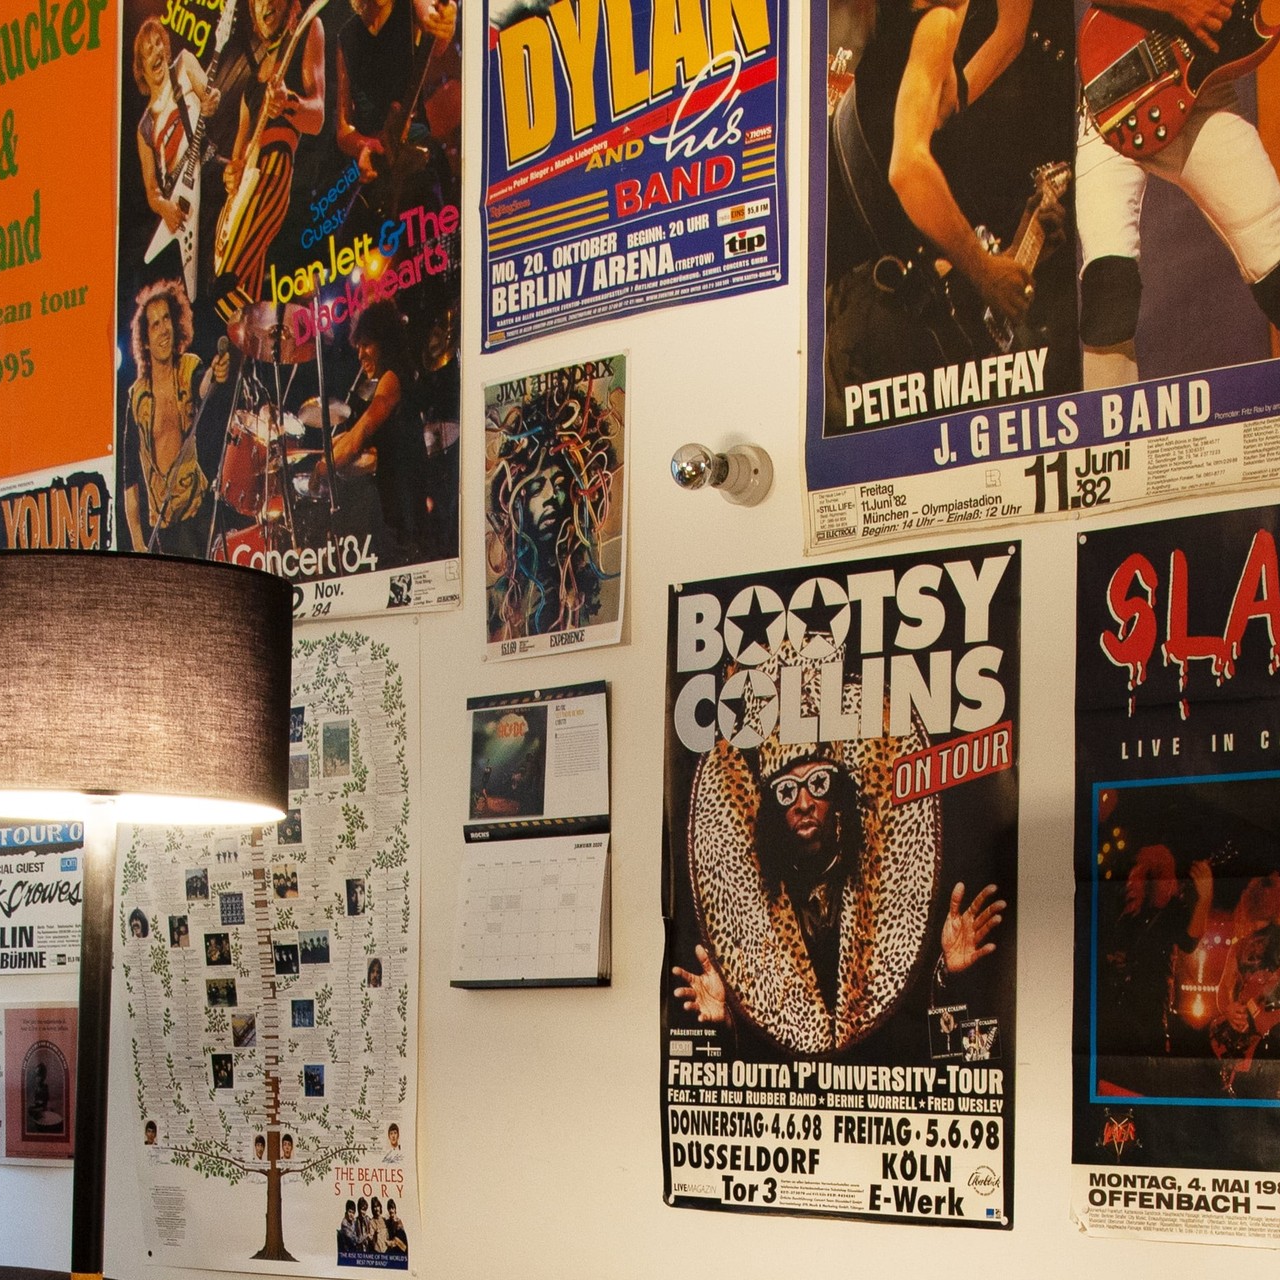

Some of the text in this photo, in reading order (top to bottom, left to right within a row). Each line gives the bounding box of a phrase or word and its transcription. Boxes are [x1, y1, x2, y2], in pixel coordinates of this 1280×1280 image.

[160, 0, 212, 58] Sting
[585, 139, 644, 173] AND
[310, 159, 361, 222] Special
[615, 154, 735, 218] BAND
[270, 204, 460, 309] Joan Jett & The
[492, 213, 710, 282] MO, 20. OKTOBER BEGINN: 20 UHR
[726, 231, 765, 253] tip
[40, 284, 88, 316] tour
[292, 243, 449, 347] Blackhearts
[492, 269, 572, 317] BERLIN
[593, 243, 675, 292] ARENA
[675, 252, 714, 271] (TREPTOW)
[496, 358, 614, 403] JIMI HENDRIX
[844, 346, 1048, 427] PETER MAFFAY
[933, 379, 1211, 466] J. GEILS BAND
[1075, 441, 1130, 478] Juni
[859, 483, 894, 499] Freitag
[863, 509, 909, 526] München
[921, 494, 1002, 516] Olympiastadion
[1077, 476, 1111, 508] '82
[1, 482, 101, 550] YOUNG
[862, 503, 1022, 538] Beginn: Uhr Einlaß: 12 Uhr
[231, 534, 378, 578] Concert '84
[314, 581, 345, 600] Nov.
[677, 555, 1012, 673] BOOTSY
[674, 646, 1006, 753] COLLINS
[894, 728, 1011, 800] ON TOUR
[1122, 736, 1181, 760] LIVE
[1211, 732, 1234, 753] IN
[16, 862, 45, 873] GUEST
[7, 879, 83, 916] Crowes
[671, 1109, 1000, 1150] DONNERSTAG 4.6.98 FREITAG 5.6.98
[334, 1167, 404, 1183] THE BEATLES
[672, 1140, 952, 1183] DÜSSELDORF KÖLN
[334, 1182, 404, 1199] STORY
[674, 1182, 717, 1194] LIVEMAGAZIN
[721, 1175, 759, 1202] Tor
[762, 1177, 777, 1204] 3
[869, 1183, 965, 1216] E-Werk
[1089, 1173, 1182, 1192] MONTAG,
[1188, 1178, 1206, 1191] 4.
[1212, 1178, 1249, 1193] MAI
[1089, 1189, 1250, 1213] OFFENBACH
